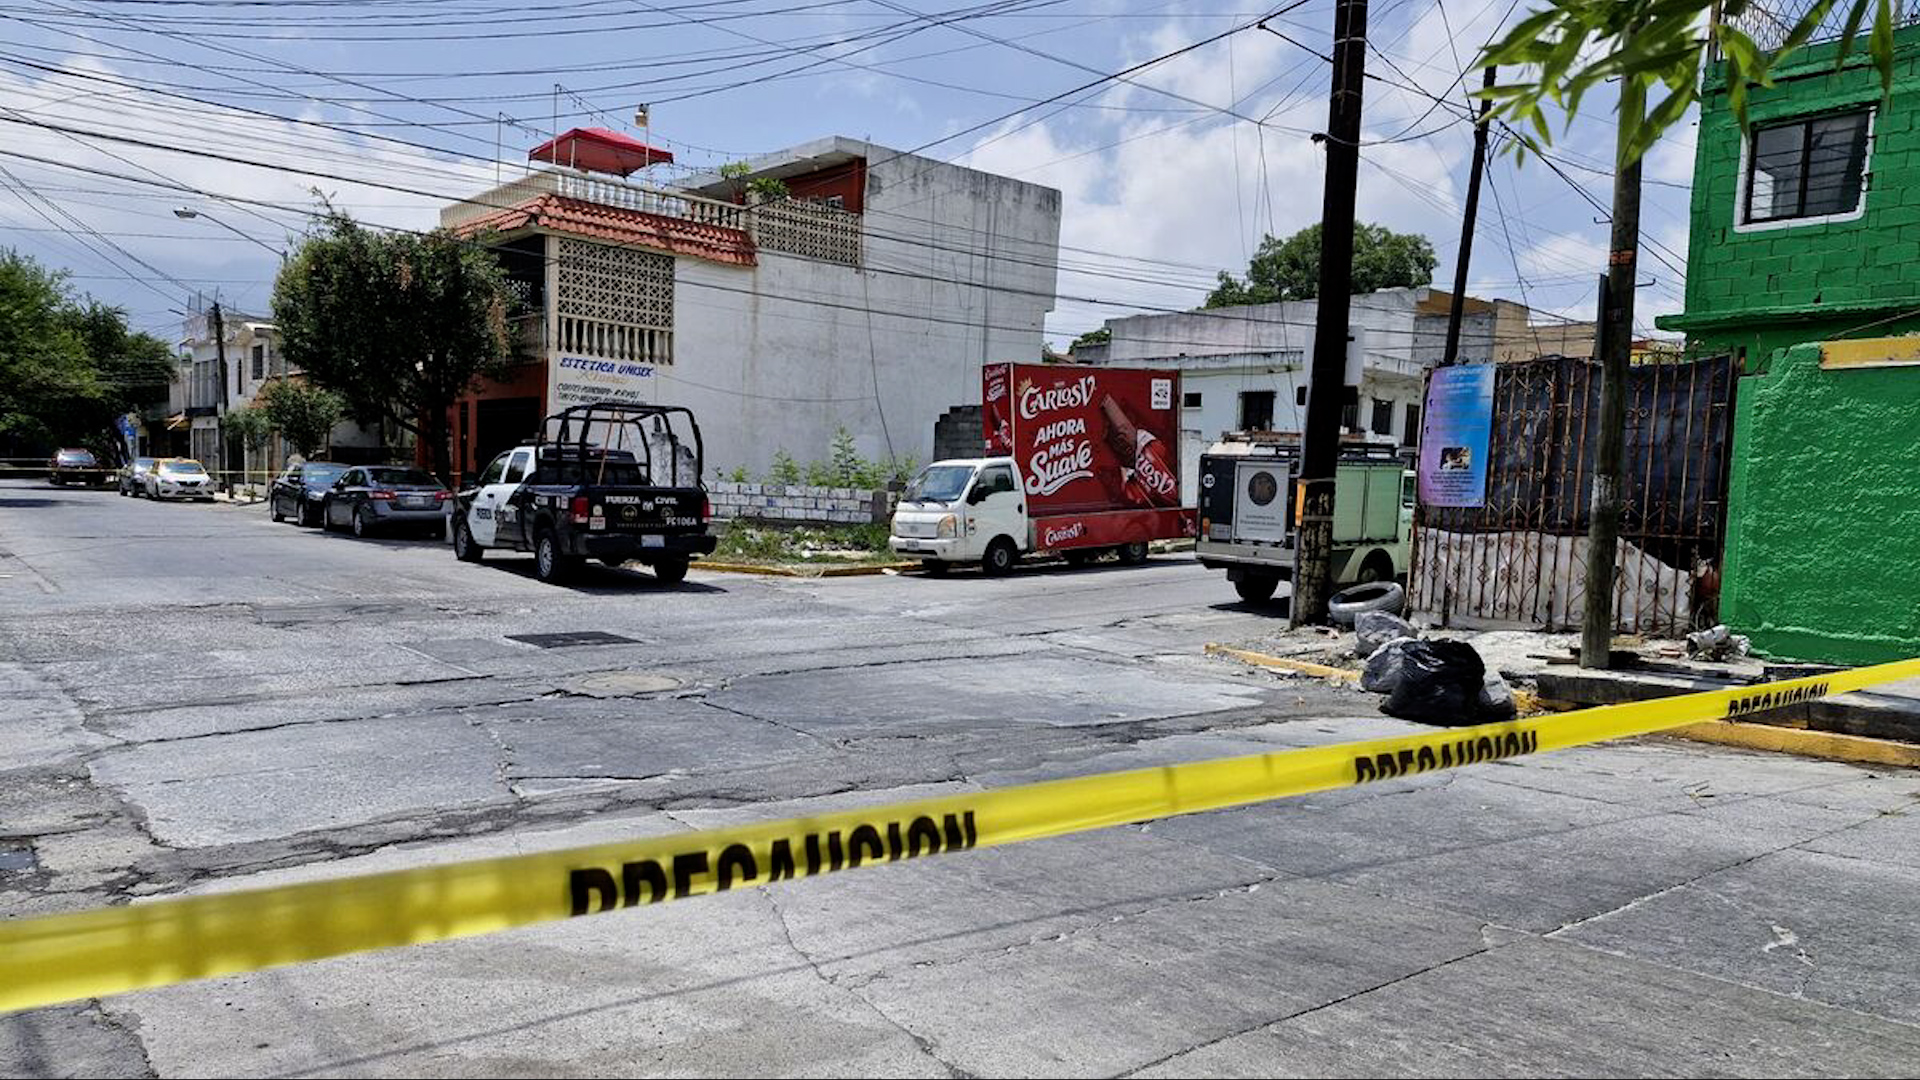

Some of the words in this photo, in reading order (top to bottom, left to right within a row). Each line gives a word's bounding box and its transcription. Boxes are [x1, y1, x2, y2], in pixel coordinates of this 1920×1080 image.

[560, 357, 615, 372] ESTETICA
[617, 364, 654, 378] UNISEX
[1033, 418, 1086, 448] AHORA
[1049, 438, 1075, 459] MÁS
[1025, 440, 1094, 495] Suave
[605, 496, 641, 504] FUERZA
